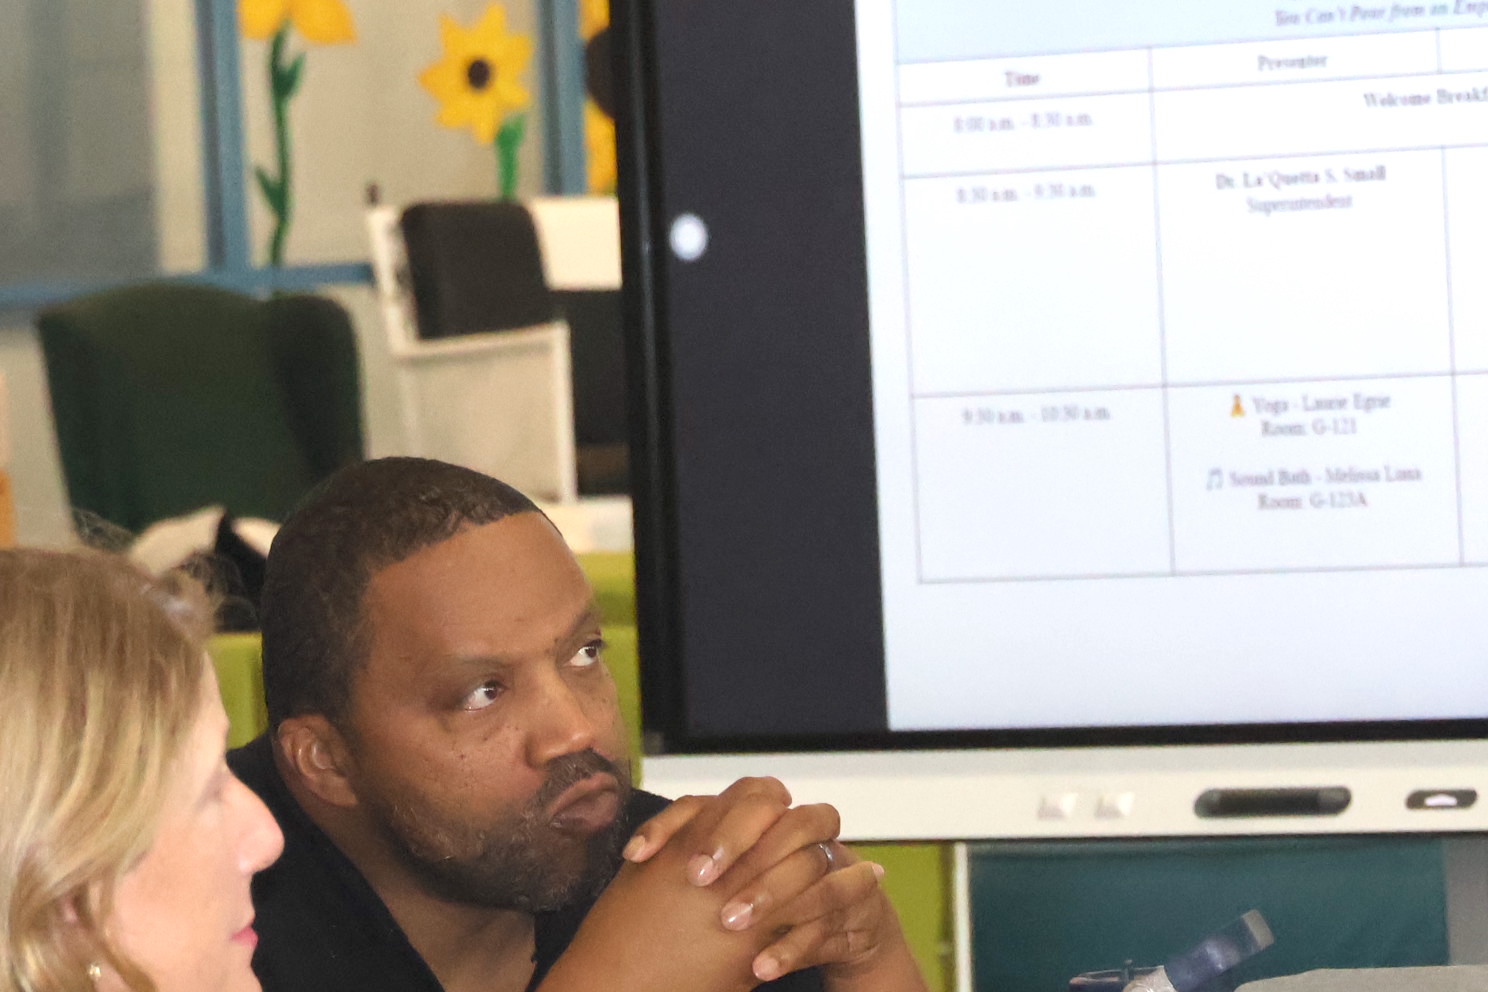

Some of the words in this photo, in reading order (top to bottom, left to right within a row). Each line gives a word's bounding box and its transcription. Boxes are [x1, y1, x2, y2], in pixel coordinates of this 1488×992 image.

[1258, 55, 1328, 71] Presenter
[1005, 70, 1041, 88] Time
[1364, 92, 1432, 107] Welcome
[1343, 165, 1386, 182] Small
[1252, 397, 1289, 417] Yoga
[1278, 468, 1313, 486] Bath
